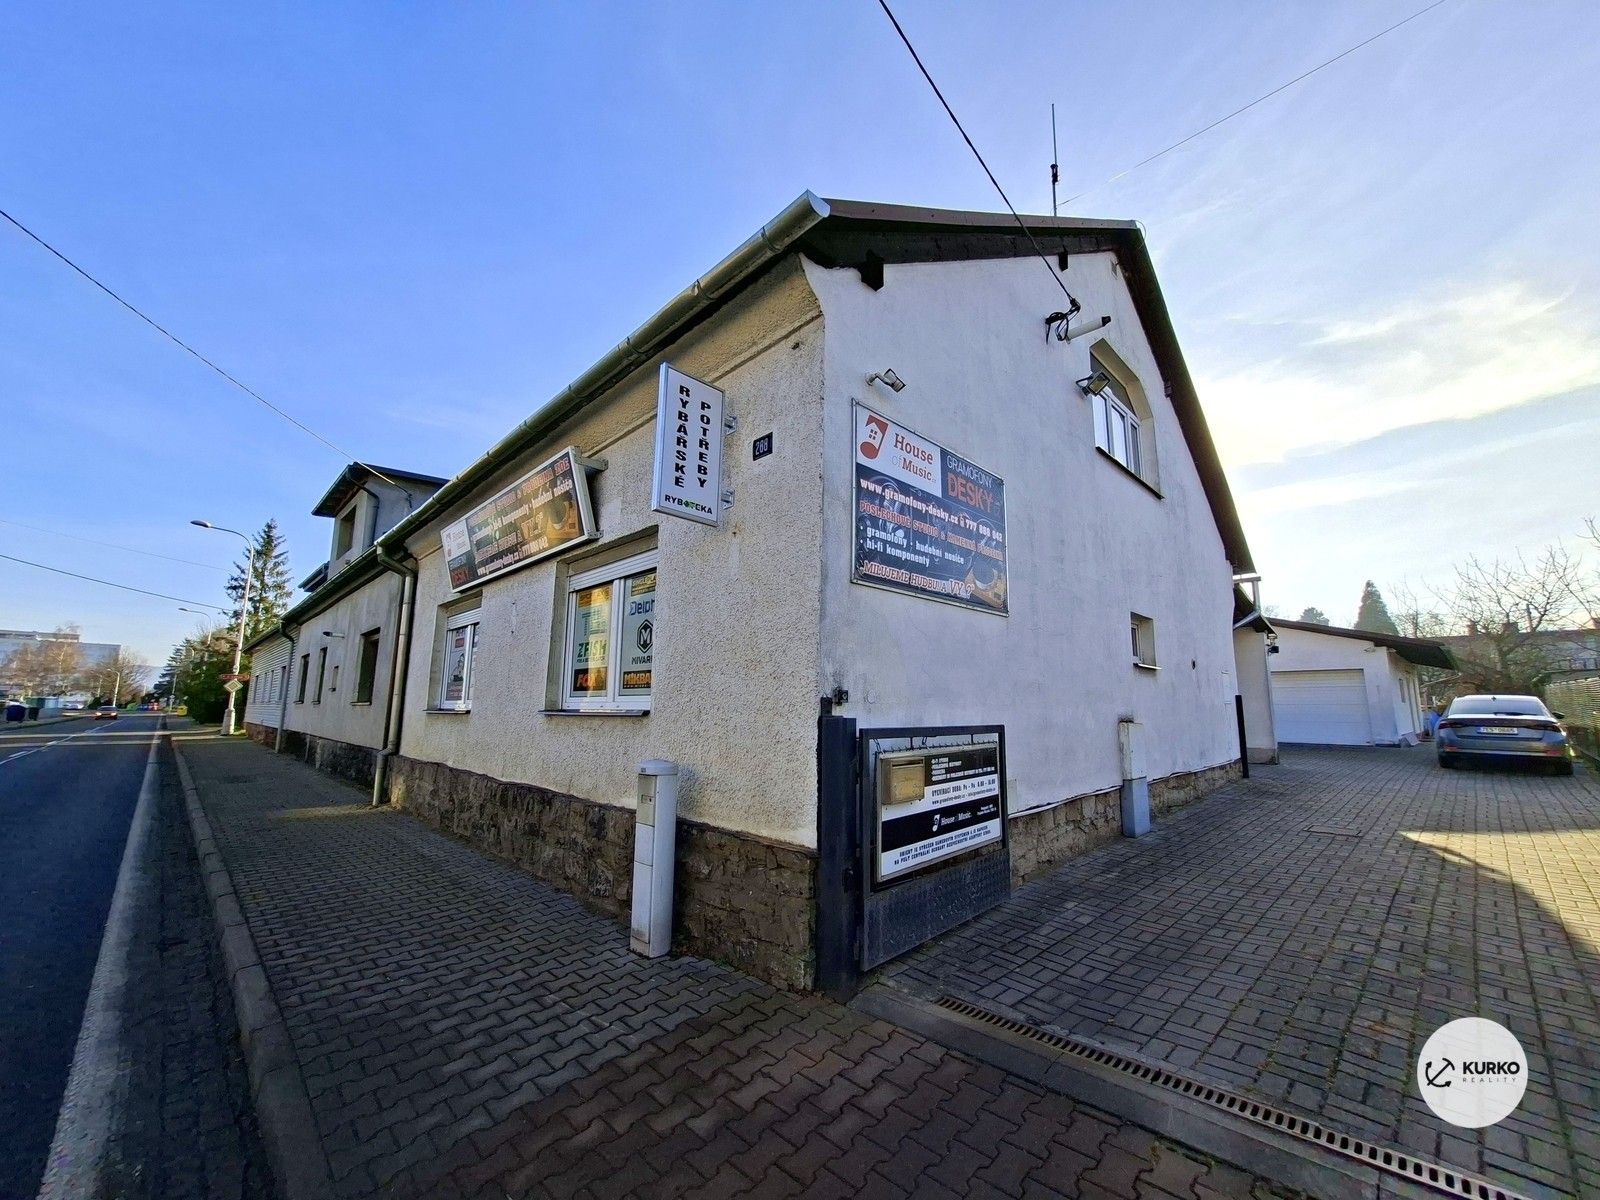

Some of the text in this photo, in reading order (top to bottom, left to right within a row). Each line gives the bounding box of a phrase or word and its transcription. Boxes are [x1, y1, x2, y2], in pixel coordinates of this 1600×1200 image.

[674, 385, 690, 488] RYBÁŘSKÉ
[698, 401, 712, 488] POTŘEBY
[893, 432, 932, 466] House
[946, 454, 991, 489] GRAMOFONY
[860, 476, 957, 525] www.gramofony-desky.cz
[947, 471, 993, 514] DESKY
[866, 525, 906, 548] gramofony
[886, 545, 929, 567] komponenty
